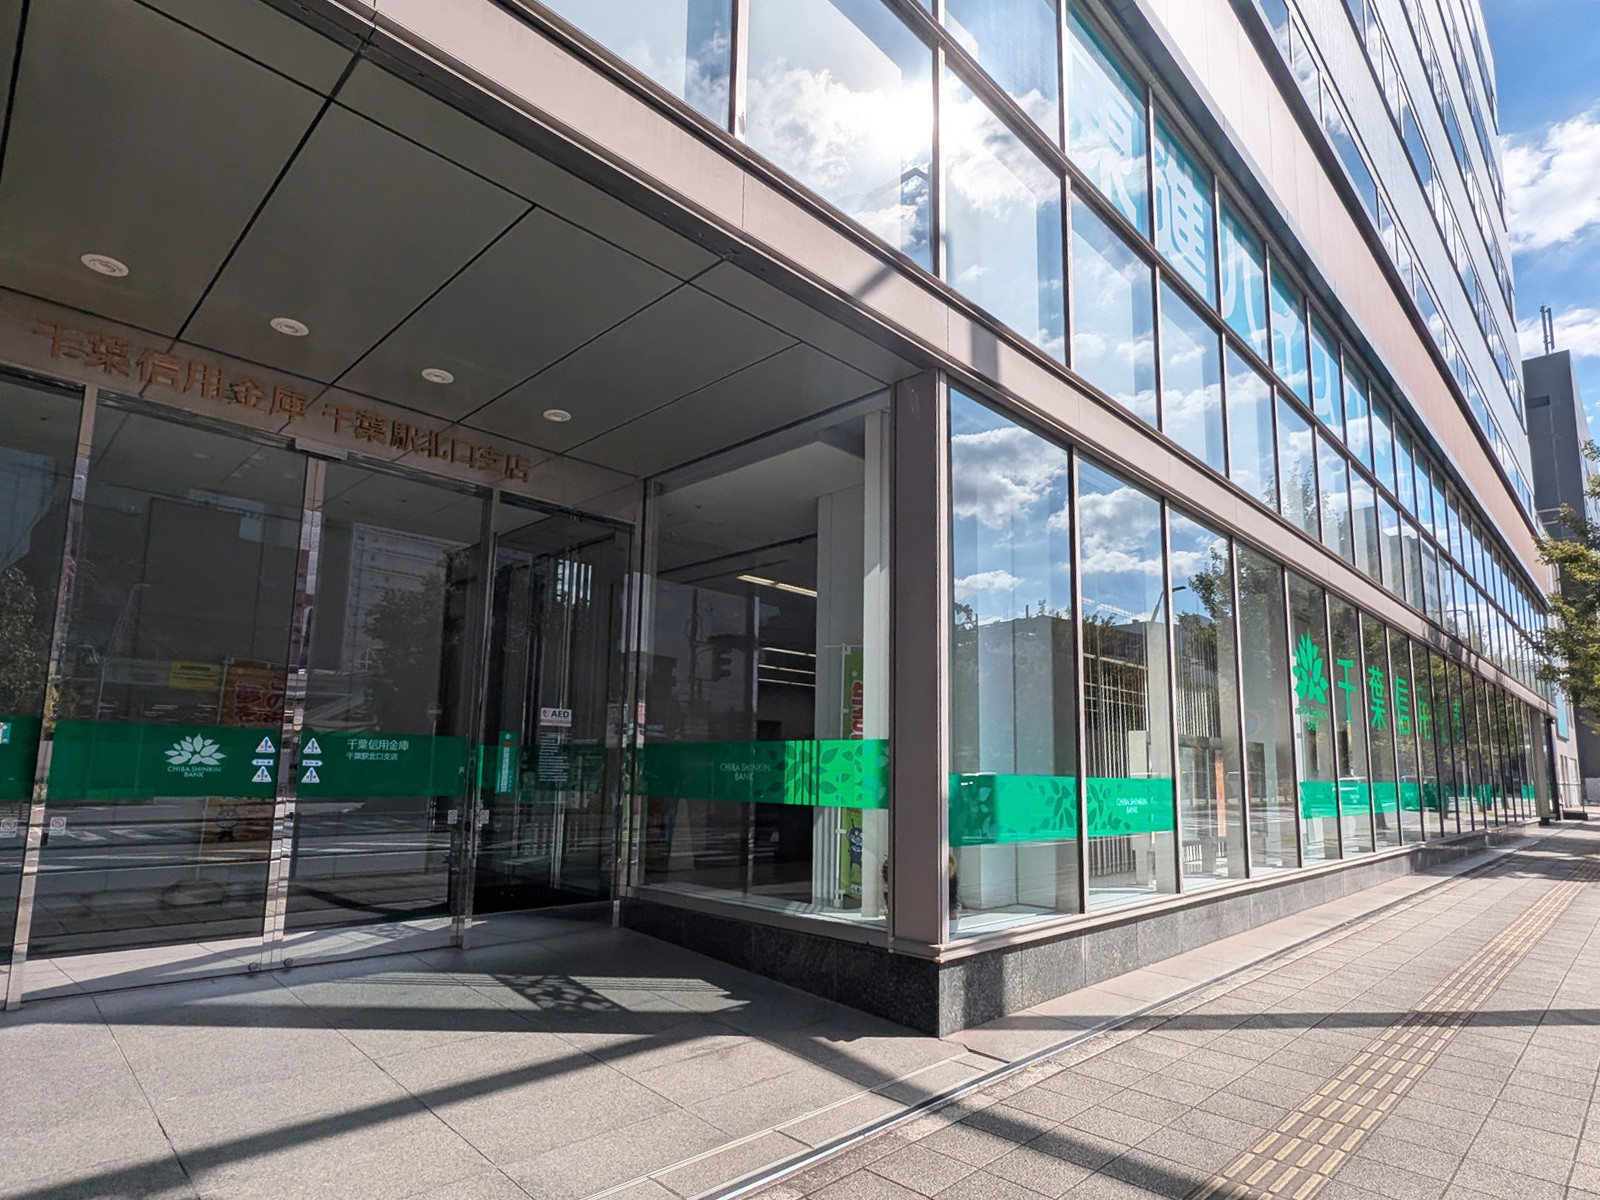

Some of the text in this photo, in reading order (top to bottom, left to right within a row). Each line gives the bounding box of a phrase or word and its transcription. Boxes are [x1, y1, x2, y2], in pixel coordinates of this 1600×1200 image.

[33, 318, 531, 483] 千葉信用金庫 千葉駅北口支店
[1337, 658, 1462, 742] 千葉信用
[551, 710, 569, 718] AED
[347, 739, 409, 750] 千葉信用金庫
[734, 772, 754, 780] BANK
